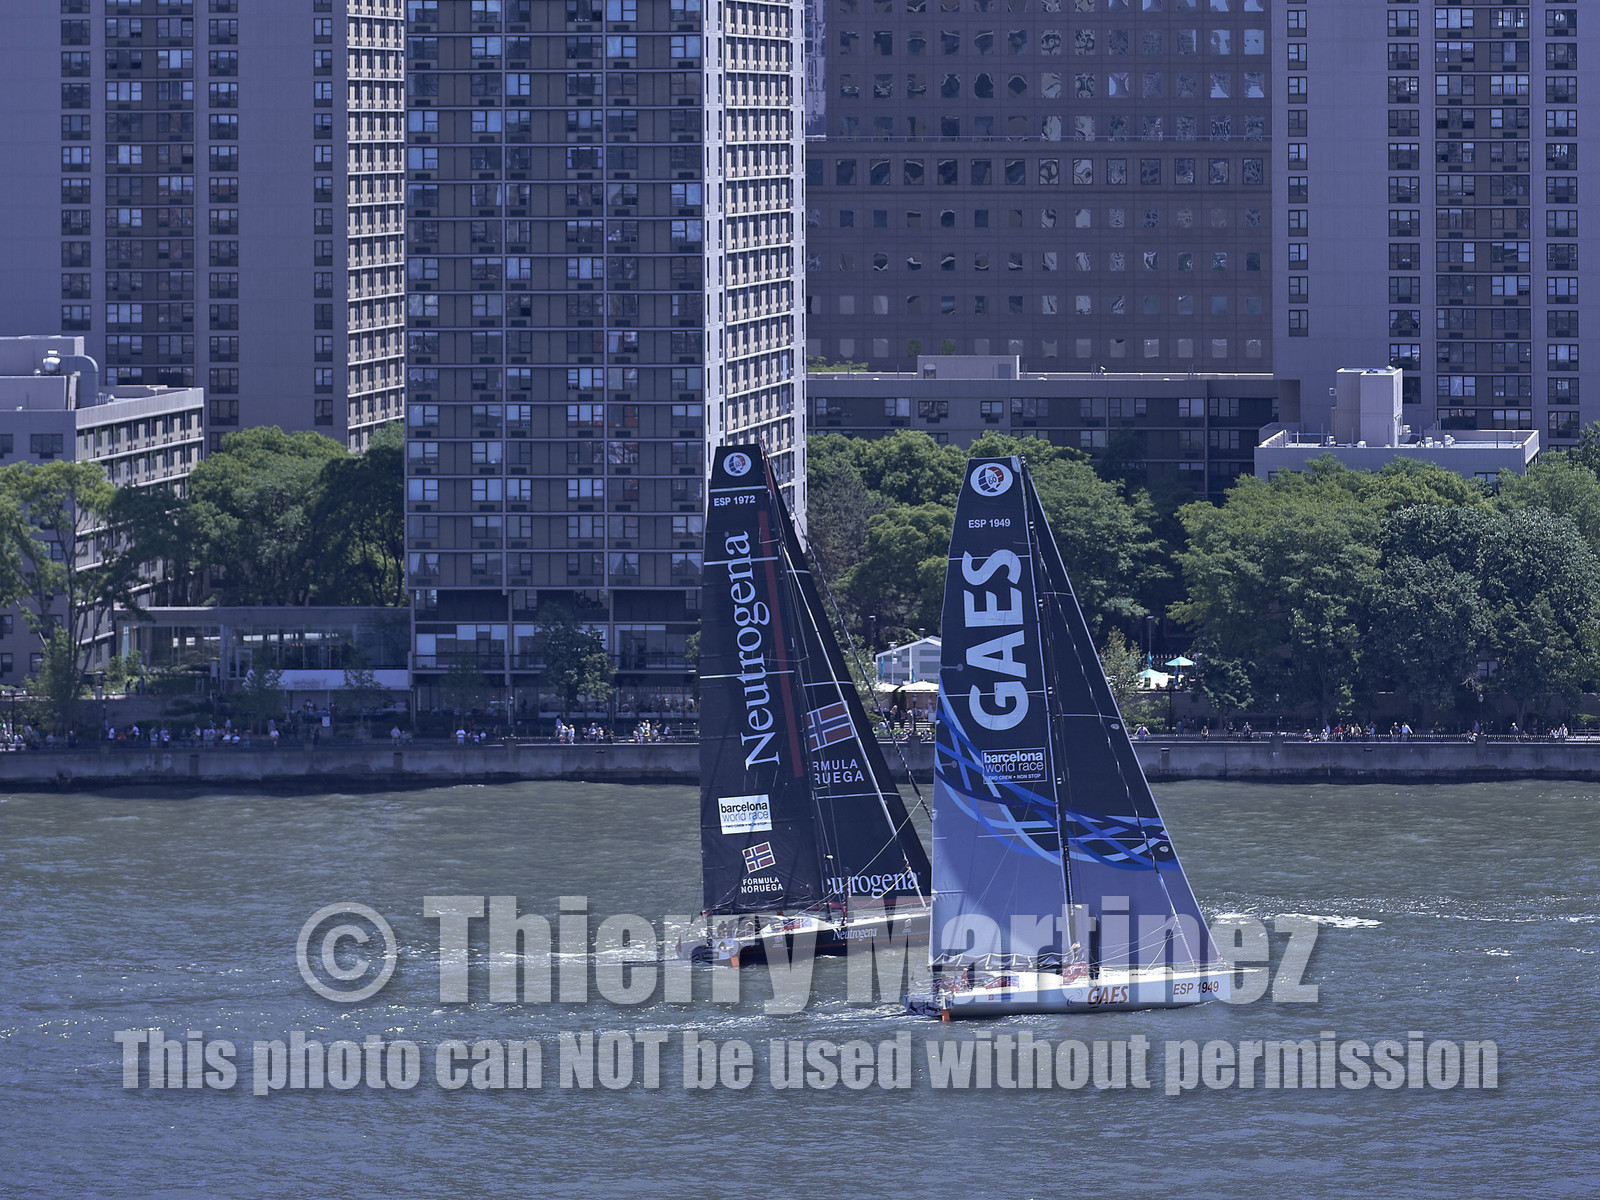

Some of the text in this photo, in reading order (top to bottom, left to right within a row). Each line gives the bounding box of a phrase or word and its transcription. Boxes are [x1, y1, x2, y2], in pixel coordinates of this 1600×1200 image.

[713, 495, 756, 506] ESP 1972
[968, 518, 1011, 529] ESP 1949
[961, 549, 1030, 731] GAES
[725, 530, 781, 771] Neutrogena
[984, 751, 1044, 764] barcelona
[812, 758, 858, 771] RMULA
[985, 761, 1044, 773] world race
[814, 770, 865, 785] RUEGA
[720, 802, 768, 814] barcelona
[722, 811, 769, 822] world race
[740, 883, 784, 894] NORUEGA
[832, 927, 878, 941] Neutrogena
[1173, 980, 1219, 995] ESP 1949
[1087, 985, 1129, 1005] GAES
